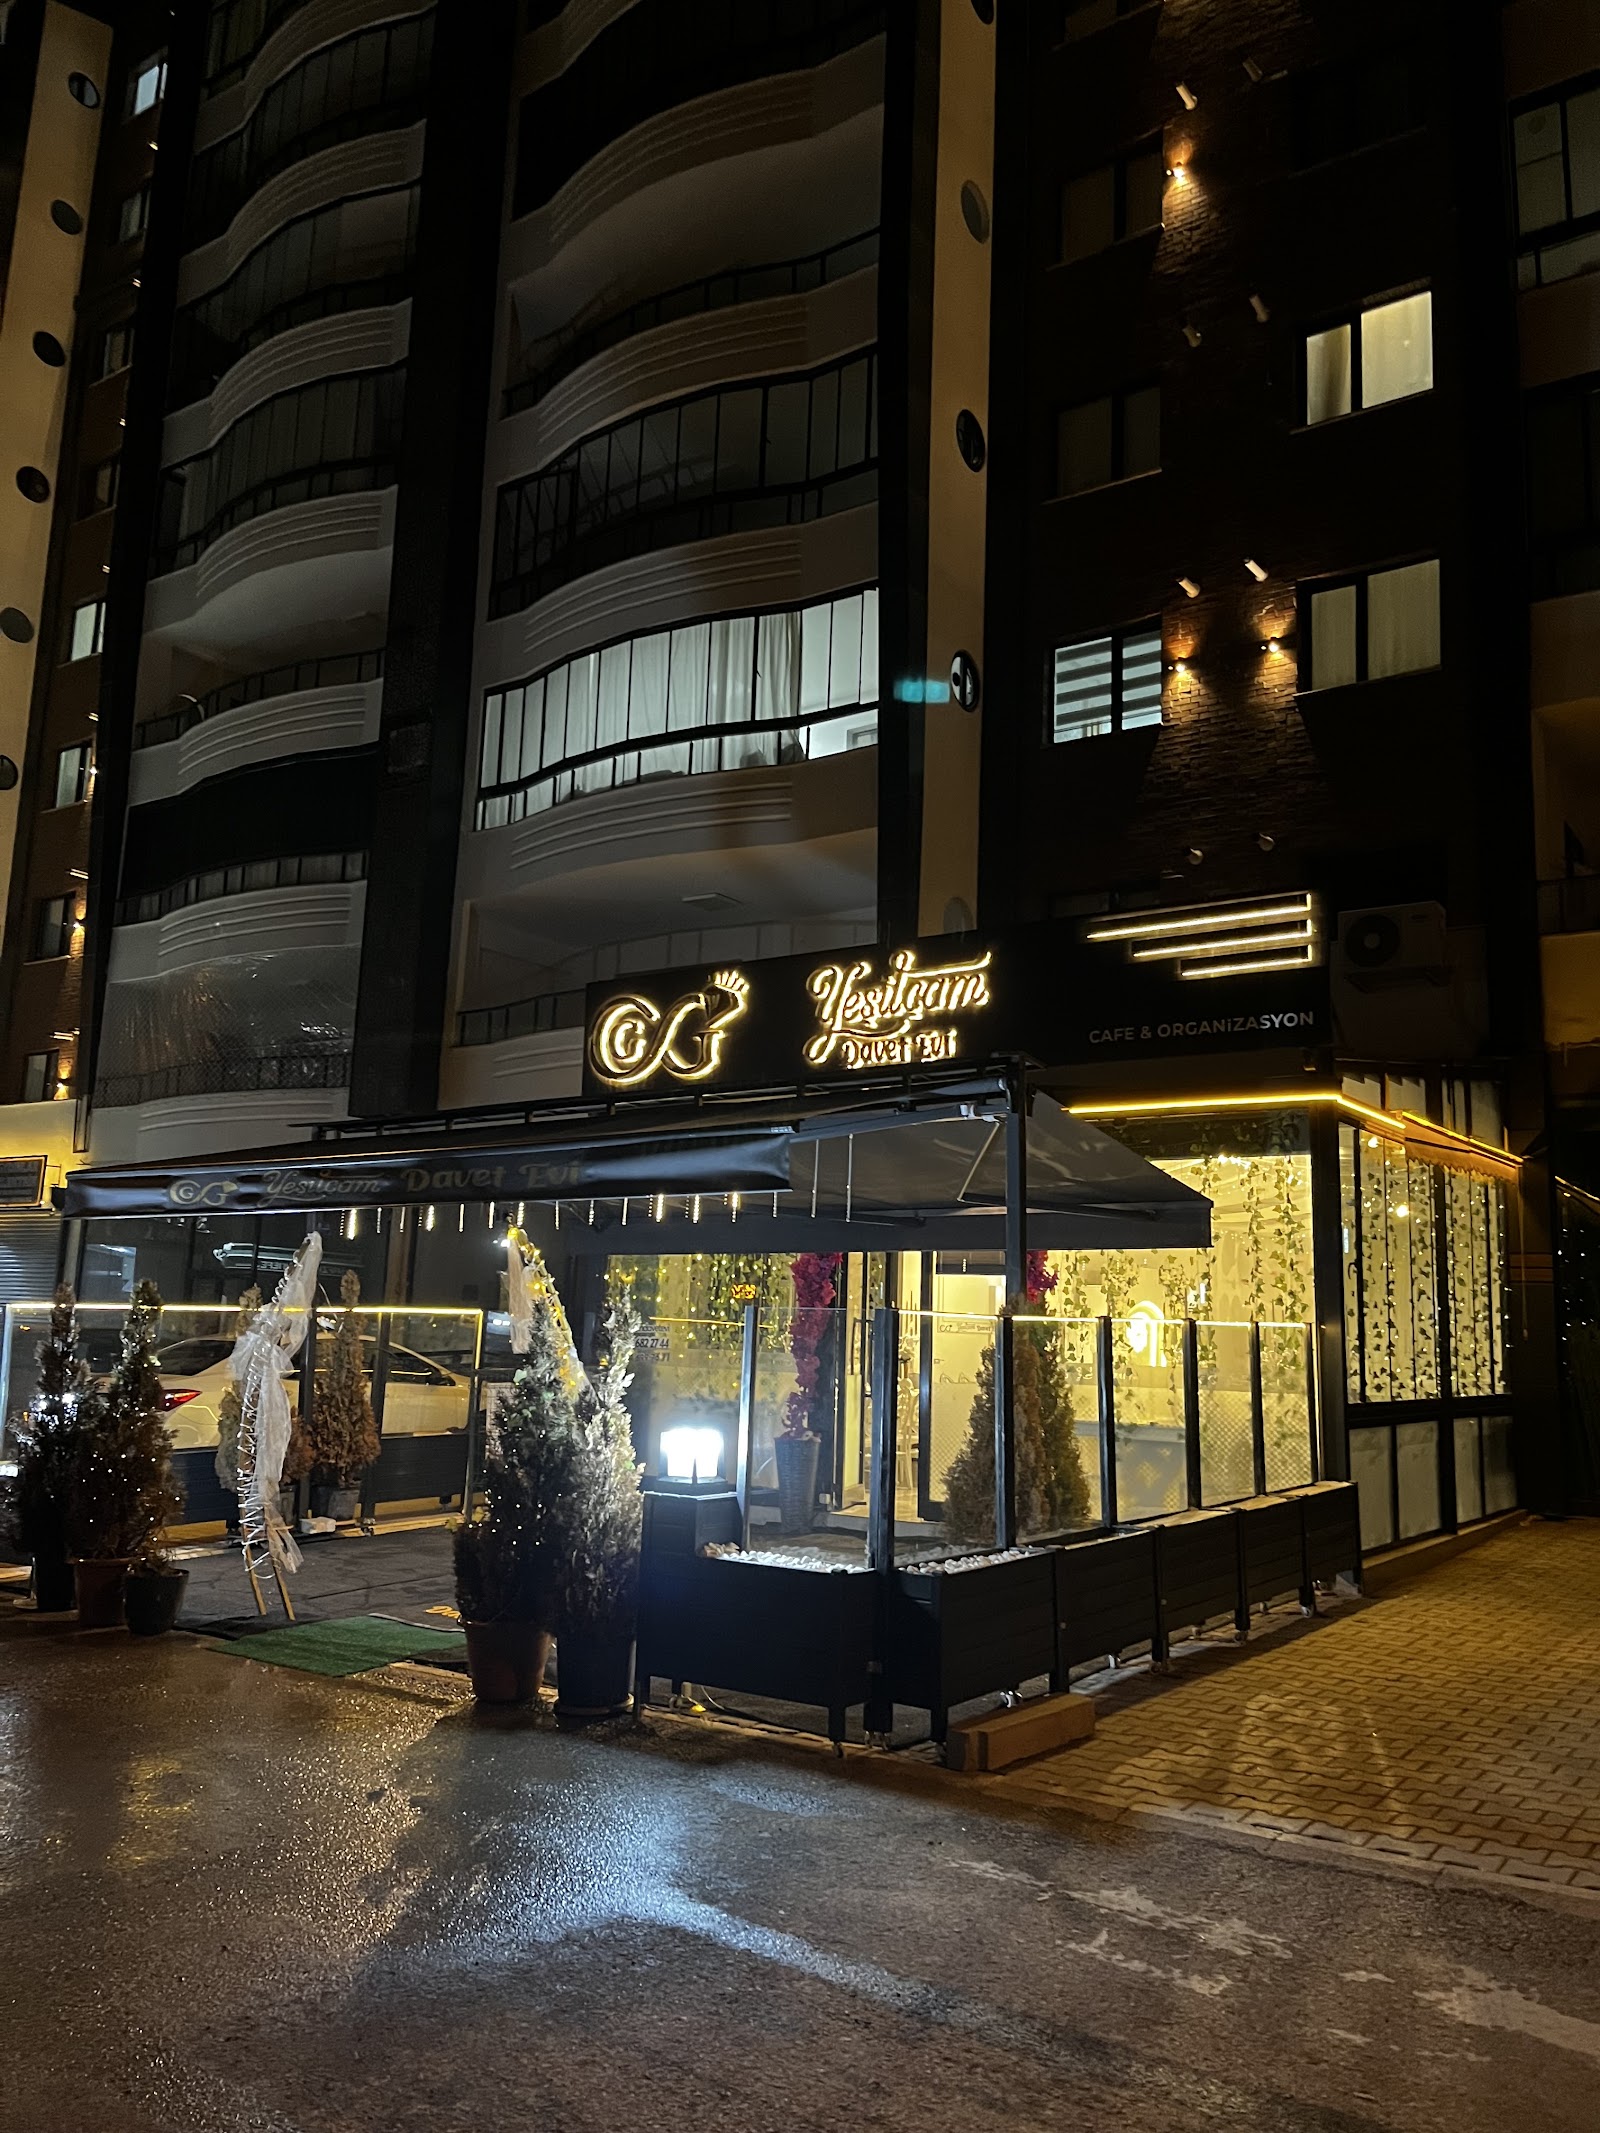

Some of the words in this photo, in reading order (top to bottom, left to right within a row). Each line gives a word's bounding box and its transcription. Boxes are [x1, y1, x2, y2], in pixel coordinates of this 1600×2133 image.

[1089, 1026, 1135, 1044] CAFE
[1140, 1025, 1151, 1040] &
[401, 1166, 506, 1193] Davet
[519, 1160, 581, 1189] Evi
